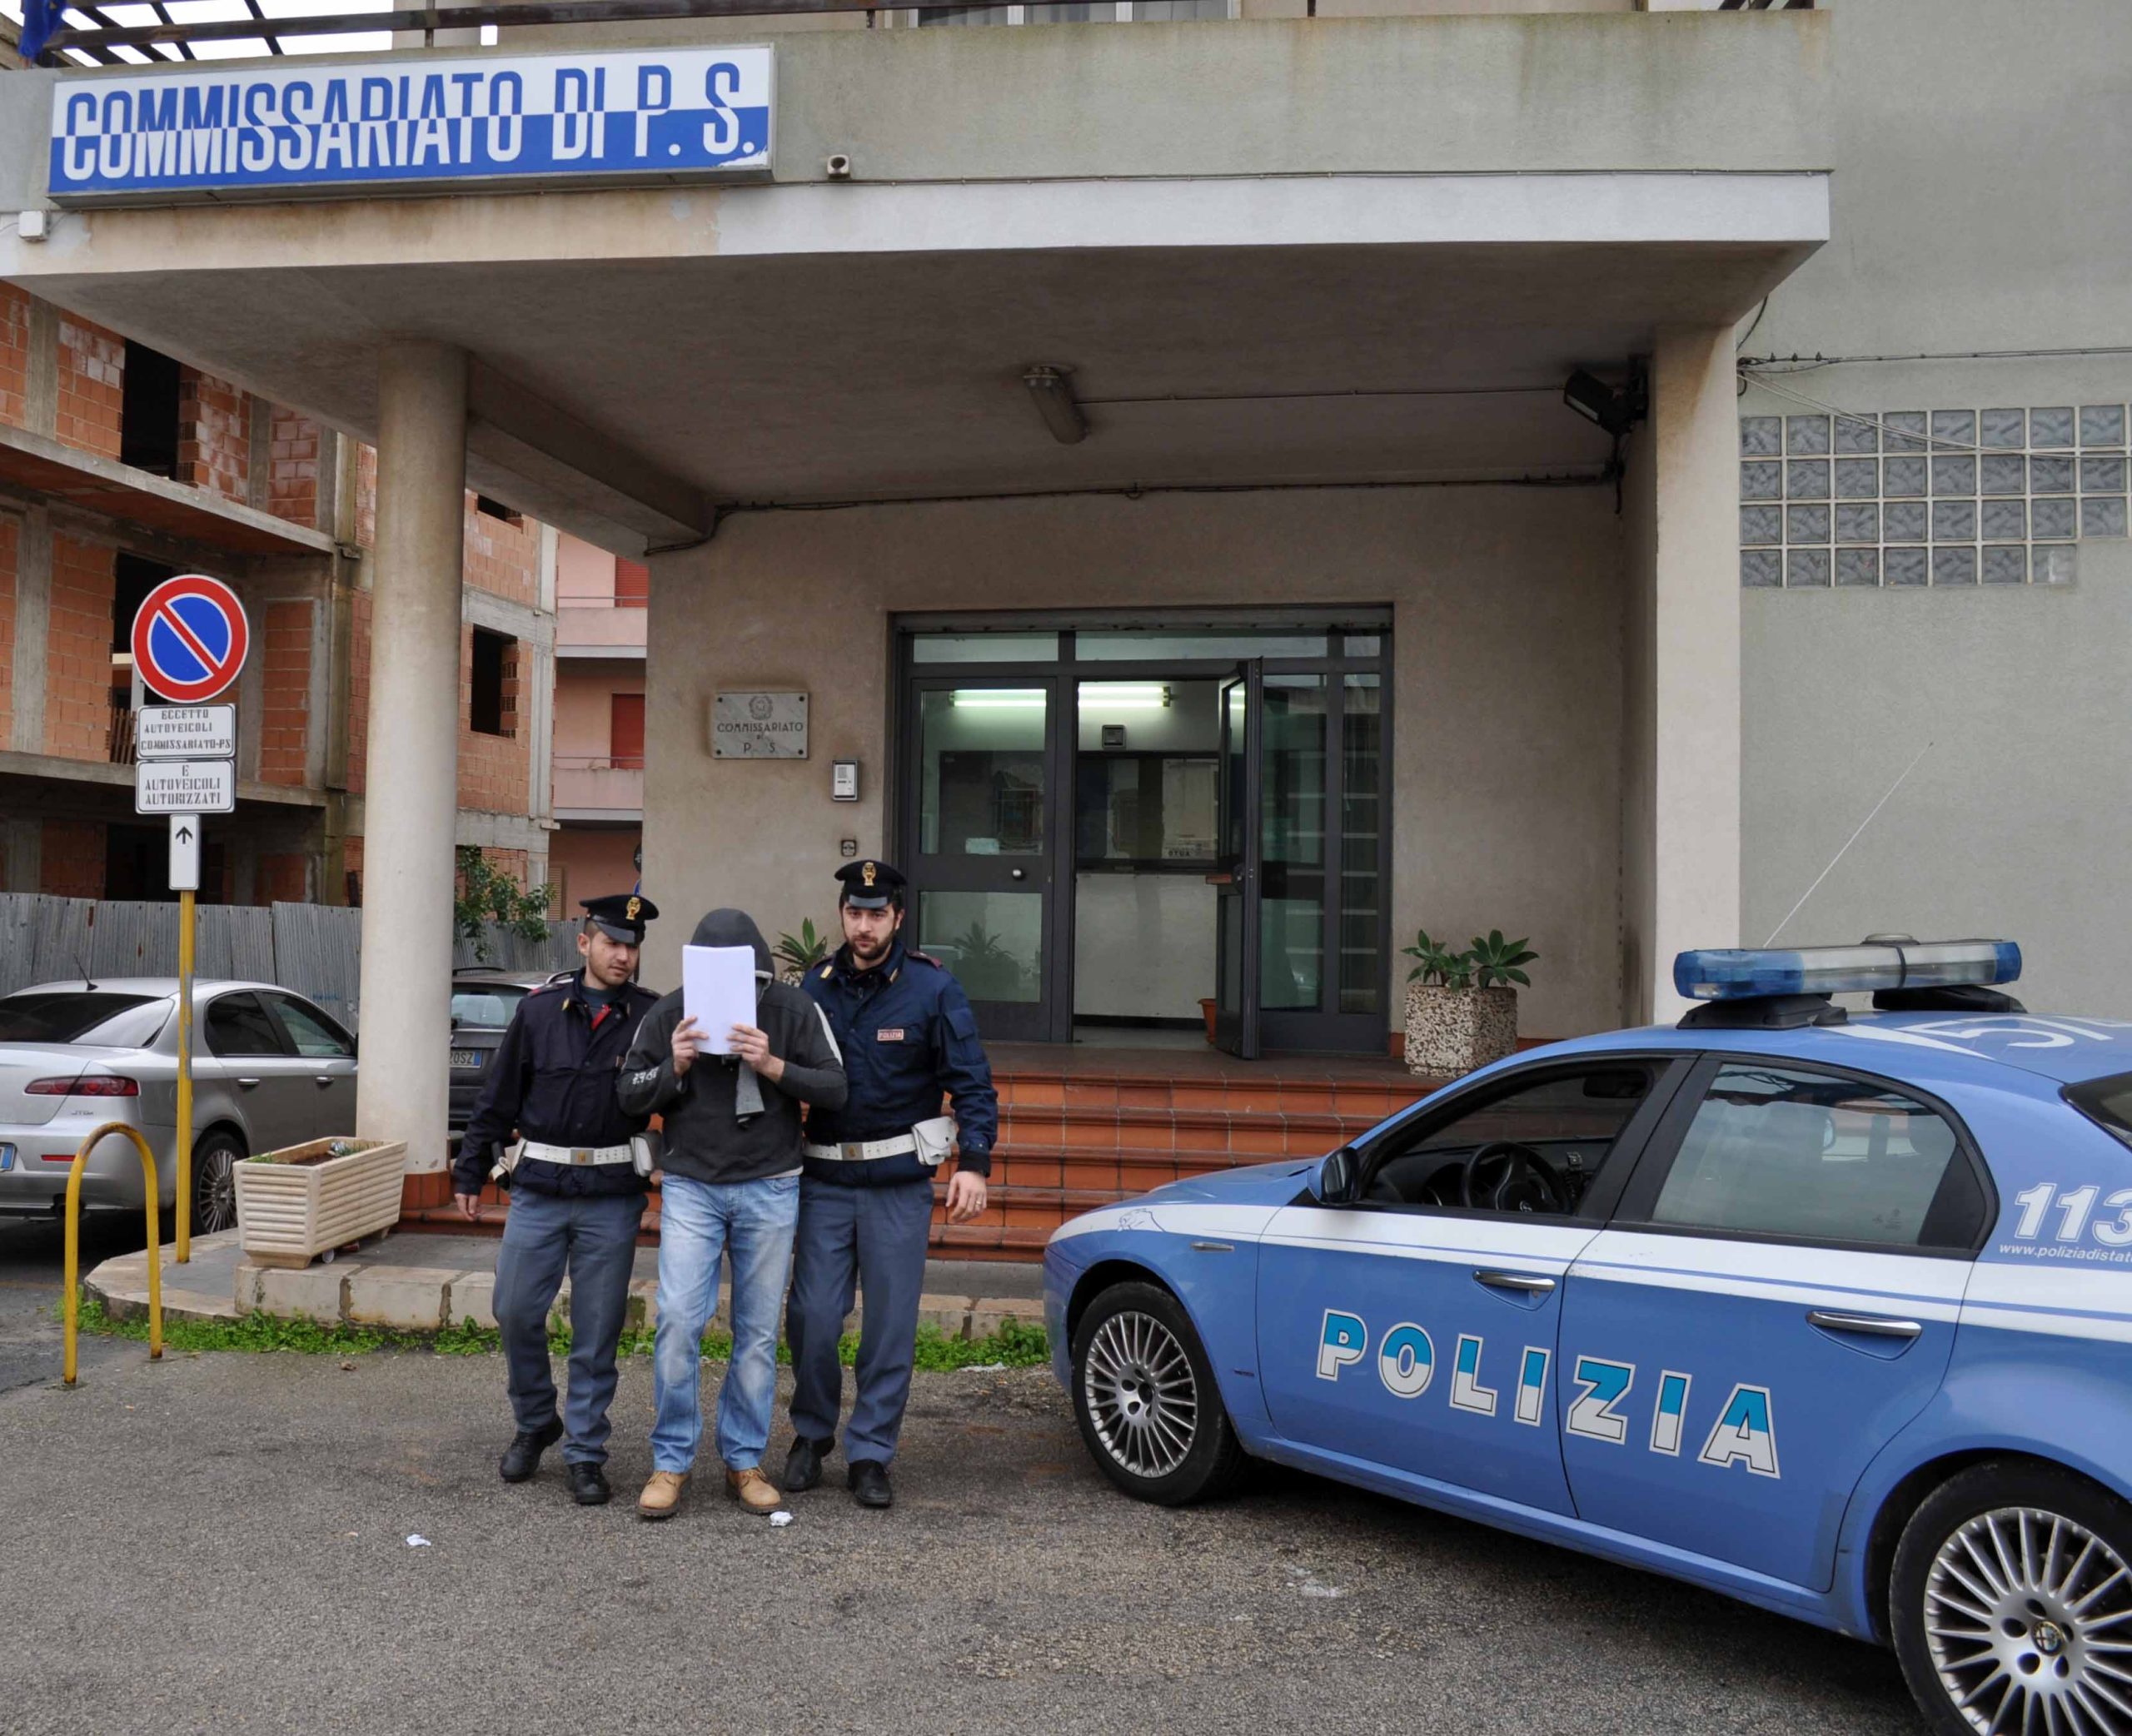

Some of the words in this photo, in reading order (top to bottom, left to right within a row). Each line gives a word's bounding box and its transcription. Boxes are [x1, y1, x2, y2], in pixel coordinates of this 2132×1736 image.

[63, 71, 524, 181] COMMISSARIATO
[552, 67, 605, 161] DI
[635, 63, 680, 157] P.
[703, 62, 756, 155] S.
[162, 709, 208, 720] ECCETTO
[144, 722, 212, 734] AUTOVEICOLI
[717, 722, 804, 733] COMMISSARIATO
[182, 764, 189, 777] E
[145, 778, 220, 791] AUTOVEICOLI
[145, 792, 220, 805] AUTORIZZATI
[2014, 1182, 2132, 1247] 113
[2000, 1243, 2132, 1263] www.poliziadistat
[1316, 1308, 1781, 1479] POLIZIA
